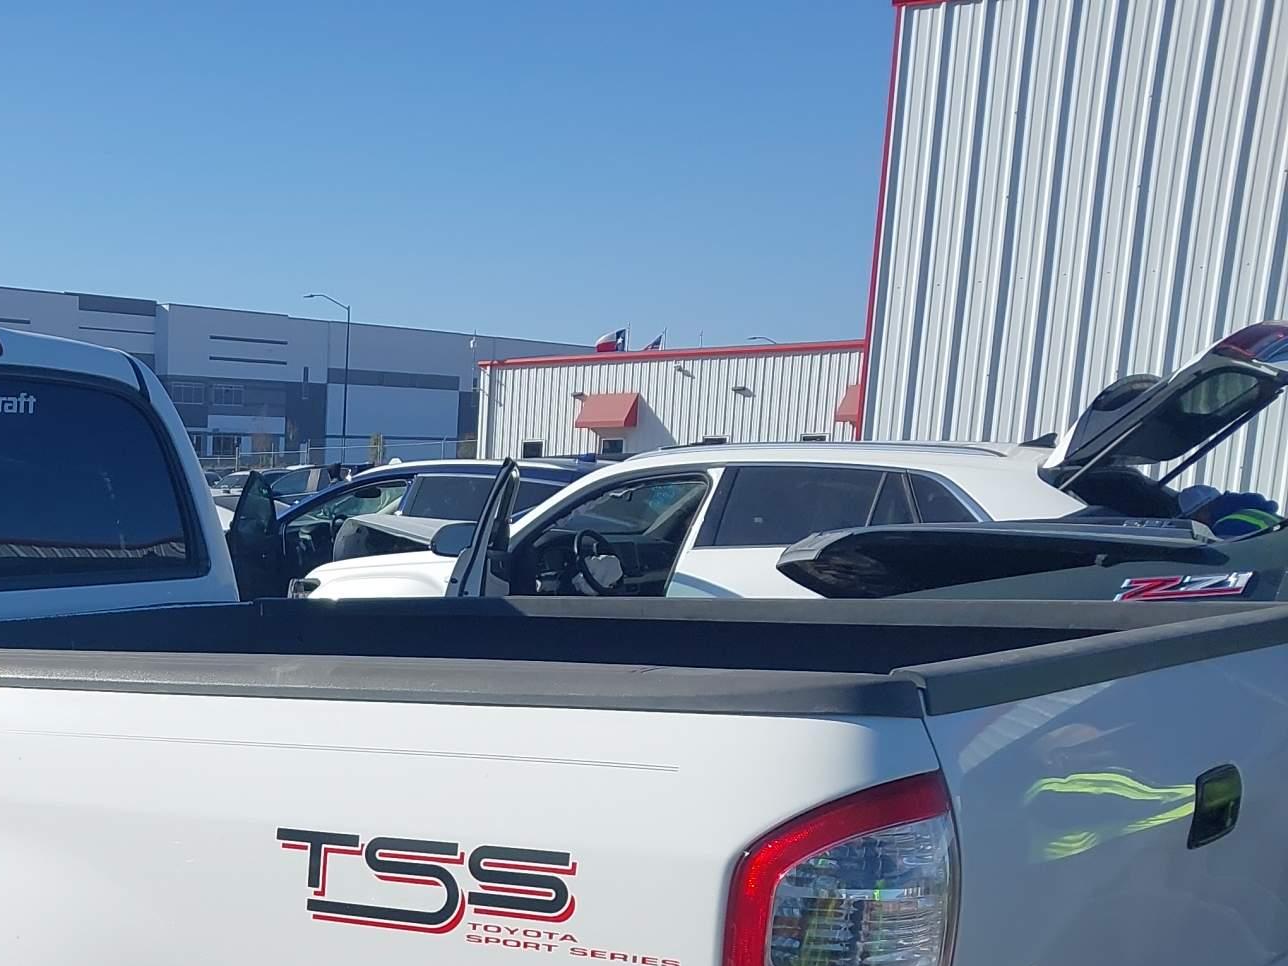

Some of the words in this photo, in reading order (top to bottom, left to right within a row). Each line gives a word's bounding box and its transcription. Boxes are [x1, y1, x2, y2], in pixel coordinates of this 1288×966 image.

[276, 826, 577, 934] TSS
[465, 934, 559, 953] SPORT
[467, 921, 579, 944] TOYOTA
